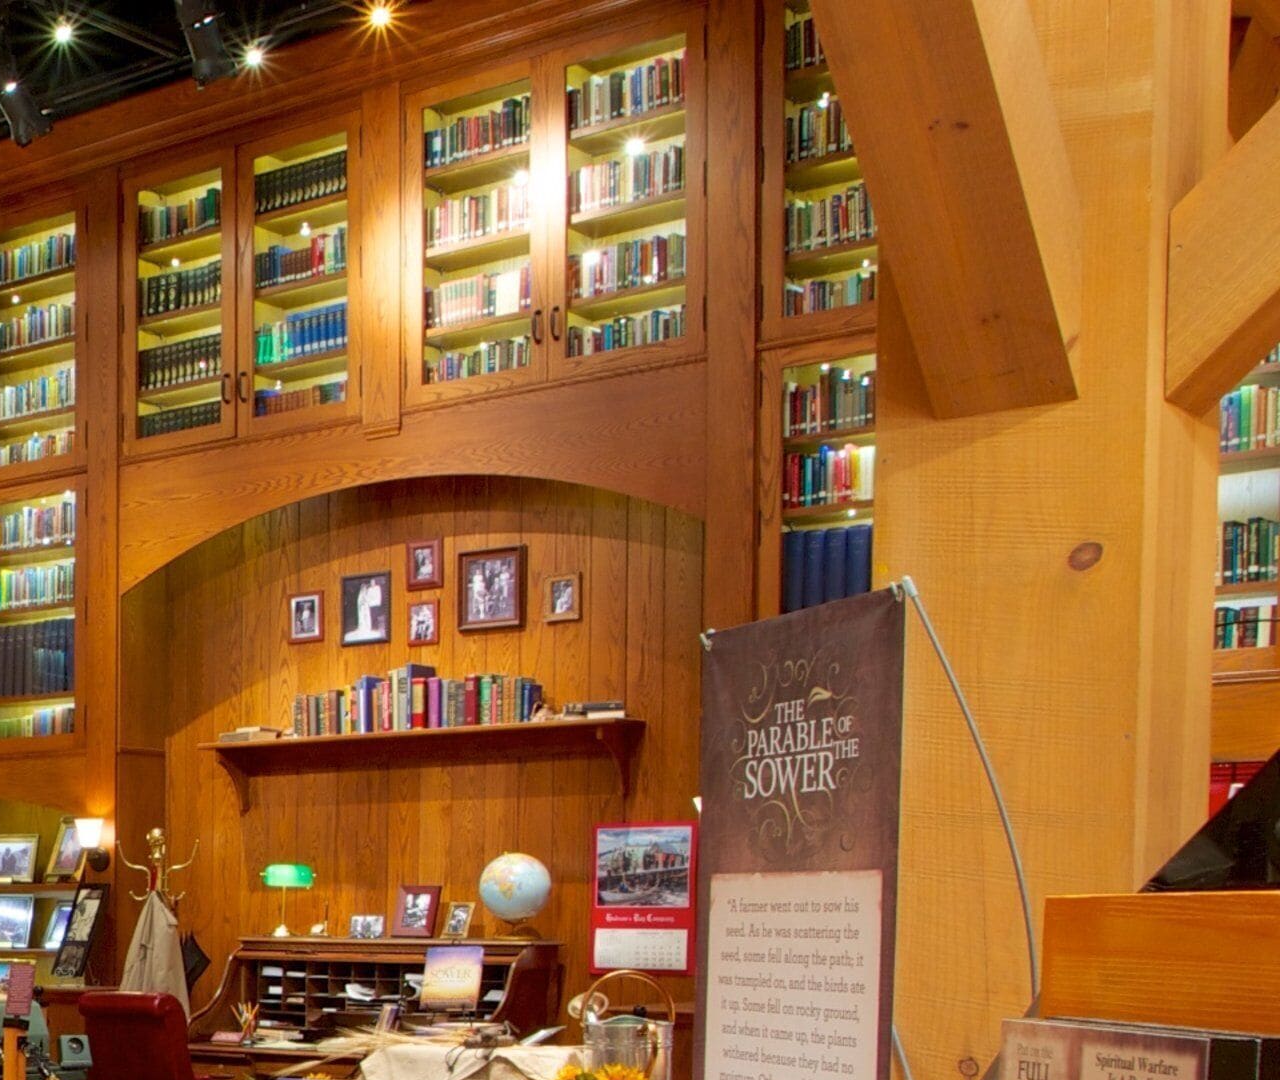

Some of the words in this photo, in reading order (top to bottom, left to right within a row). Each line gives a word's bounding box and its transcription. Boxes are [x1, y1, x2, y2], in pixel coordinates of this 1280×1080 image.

[775, 700, 804, 724] THE
[838, 716, 854, 733] OF
[748, 718, 833, 758] PARABLE
[835, 739, 859, 759] THE
[744, 752, 836, 799] SOWER
[740, 898, 768, 912] farmer
[771, 902, 791, 912] went
[794, 902, 808, 912] out
[812, 902, 821, 912] to
[823, 902, 840, 912] sow
[844, 897, 859, 913] his
[646, 913, 675, 923] Company
[749, 924, 759, 937] As
[762, 923, 772, 937] he
[775, 928, 791, 938] was
[794, 926, 840, 943] scattering
[844, 924, 859, 939] the
[743, 953, 765, 963] some
[768, 948, 782, 963] fell
[784, 949, 809, 968] along
[812, 949, 827, 966] the
[856, 952, 864, 966] it
[718, 976, 733, 985] was
[735, 973, 772, 990] trampled
[789, 975, 805, 990] and
[808, 975, 822, 991] the
[824, 976, 848, 993] birds
[851, 983, 865, 994] ate
[721, 996, 727, 1009] it
[742, 998, 765, 1013] Some
[767, 998, 780, 1014] fell
[783, 1005, 793, 1015] on
[796, 1001, 821, 1020] rocky
[721, 1020, 737, 1034] and
[739, 1020, 760, 1037] when
[762, 1025, 768, 1038] it
[771, 1030, 792, 1041] came
[811, 1027, 825, 1044] the
[827, 1029, 857, 1049] plants
[723, 1045, 759, 1063] withered
[761, 1048, 797, 1067] because
[799, 1053, 819, 1073] they
[821, 1055, 839, 1073] had
[842, 1063, 853, 1074] no
[1095, 1053, 1135, 1071] Spiritual
[1138, 1057, 1178, 1077] Warfare
